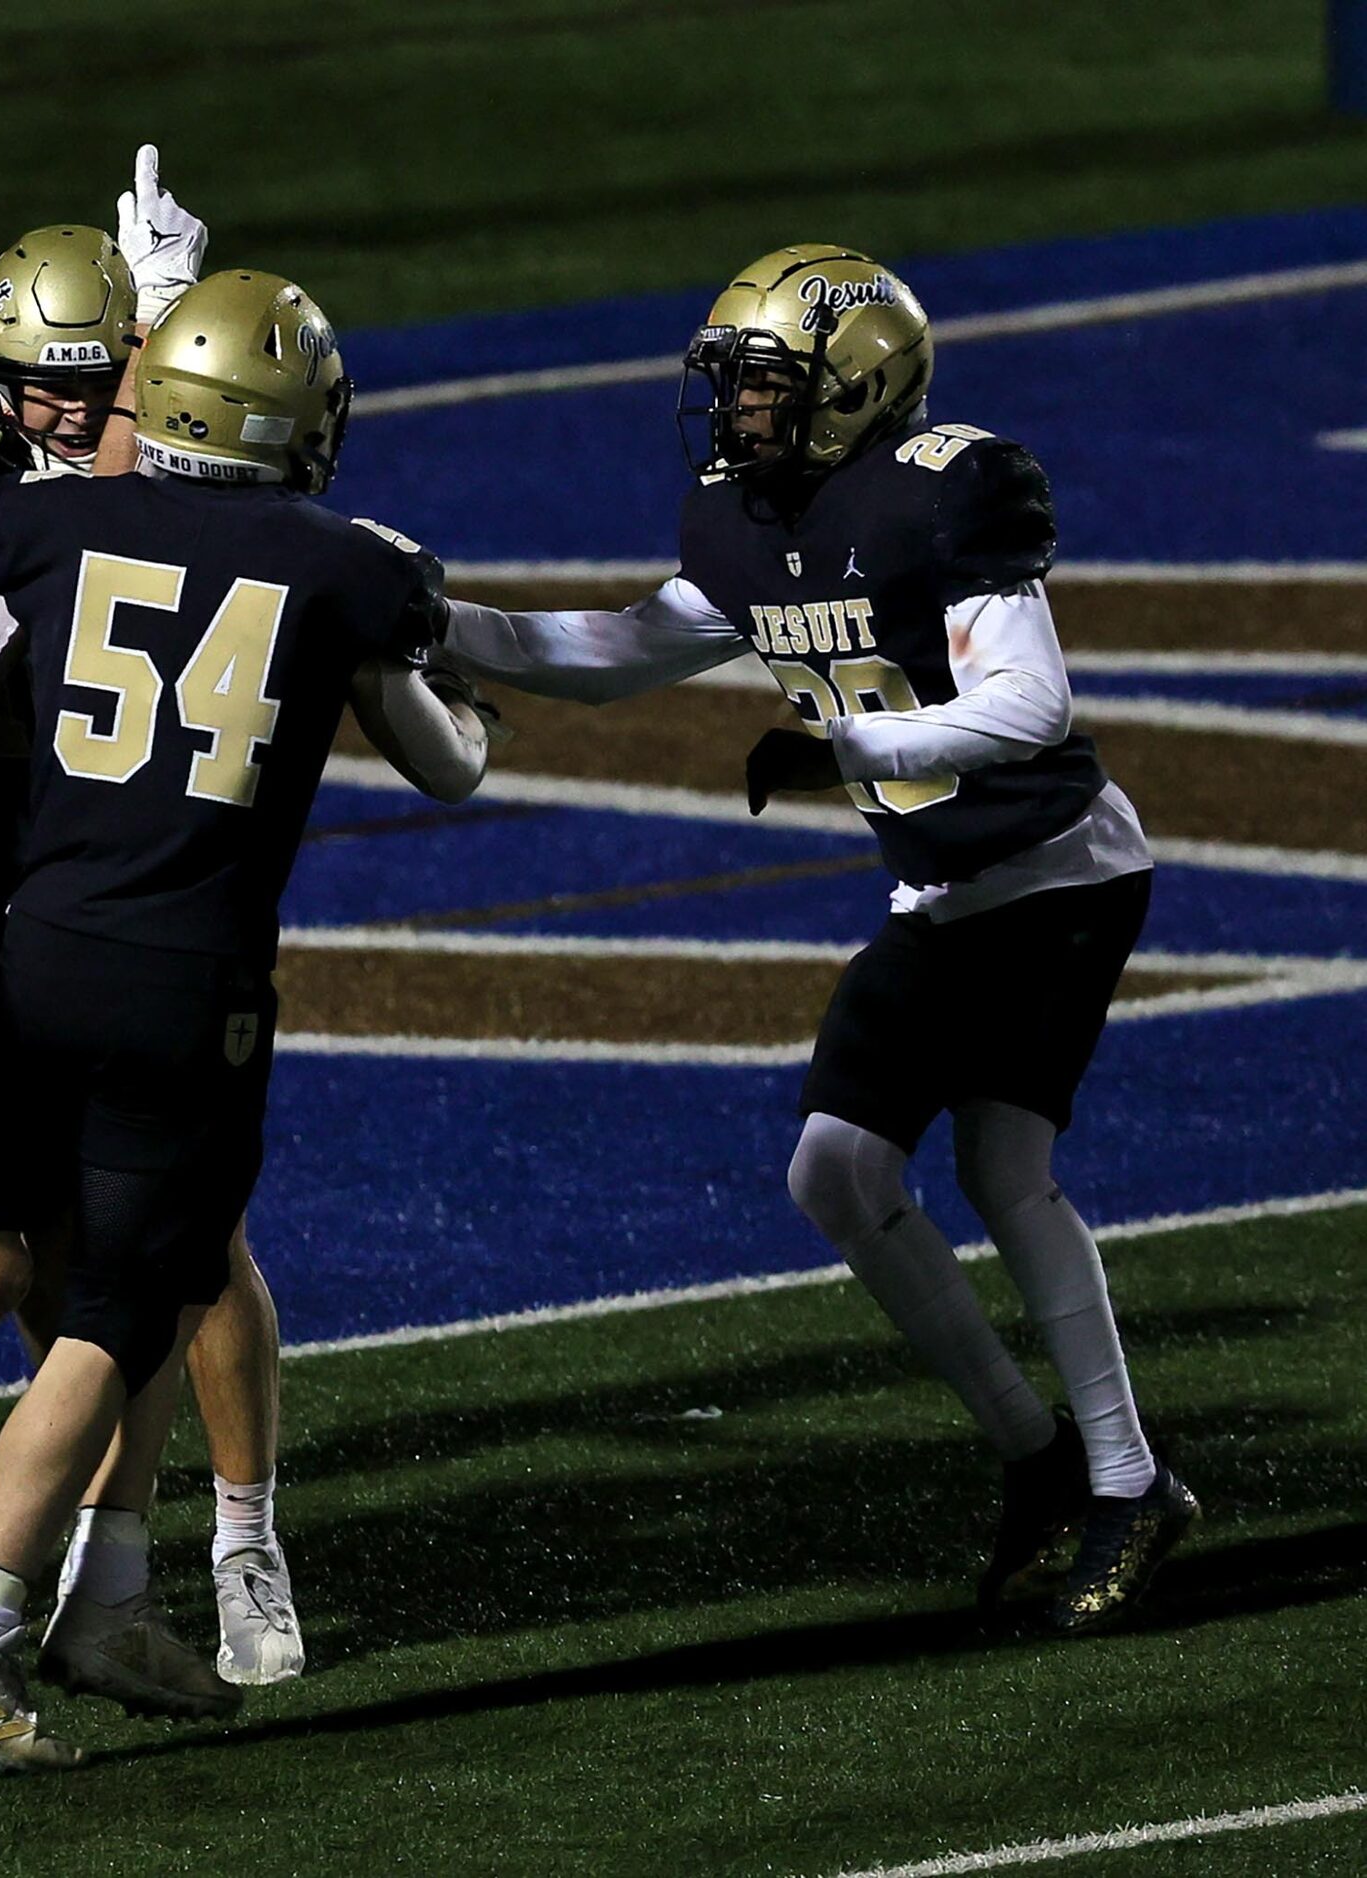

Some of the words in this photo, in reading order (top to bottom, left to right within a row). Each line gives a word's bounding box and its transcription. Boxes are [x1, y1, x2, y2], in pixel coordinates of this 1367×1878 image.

[798, 274, 896, 334] Jesuit
[46, 346, 105, 362] A.M.D.G.
[139, 439, 164, 464] EAVE
[170, 454, 191, 472] NO
[199, 461, 259, 481] DOUBT
[895, 423, 996, 472] 20
[749, 598, 877, 655] JESUIT
[52, 548, 291, 808] 54
